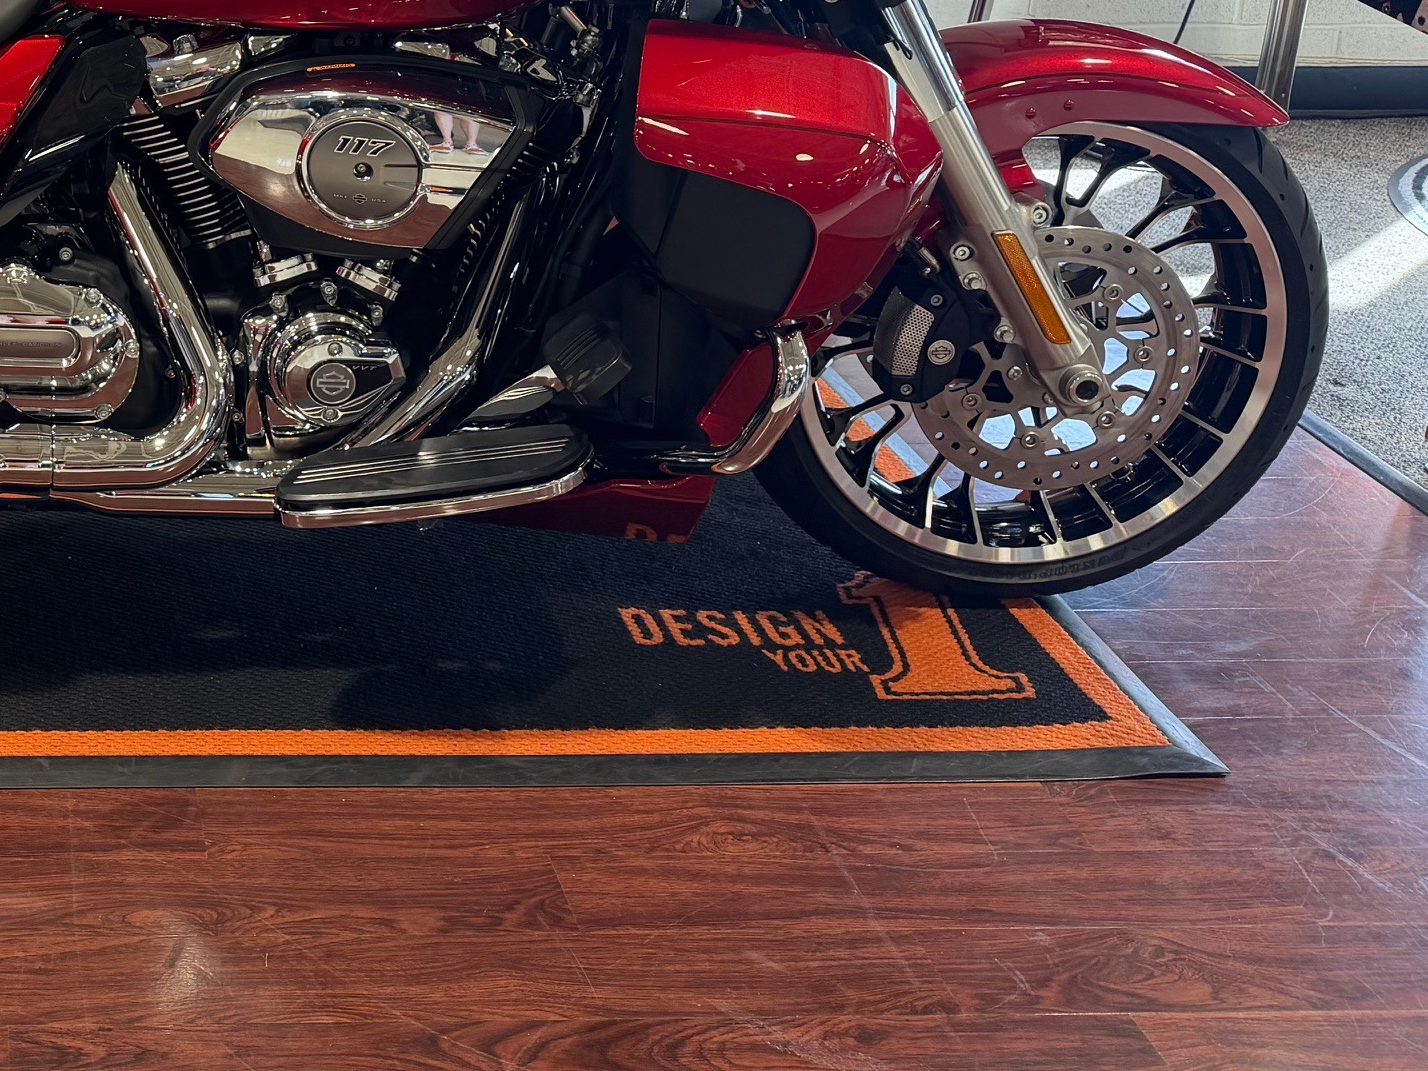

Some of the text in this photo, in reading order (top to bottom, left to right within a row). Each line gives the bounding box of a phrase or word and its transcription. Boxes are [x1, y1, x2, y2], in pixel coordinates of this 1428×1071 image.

[333, 135, 397, 158] 117
[617, 607, 848, 647] DESIGN
[761, 648, 870, 674] YOUR
